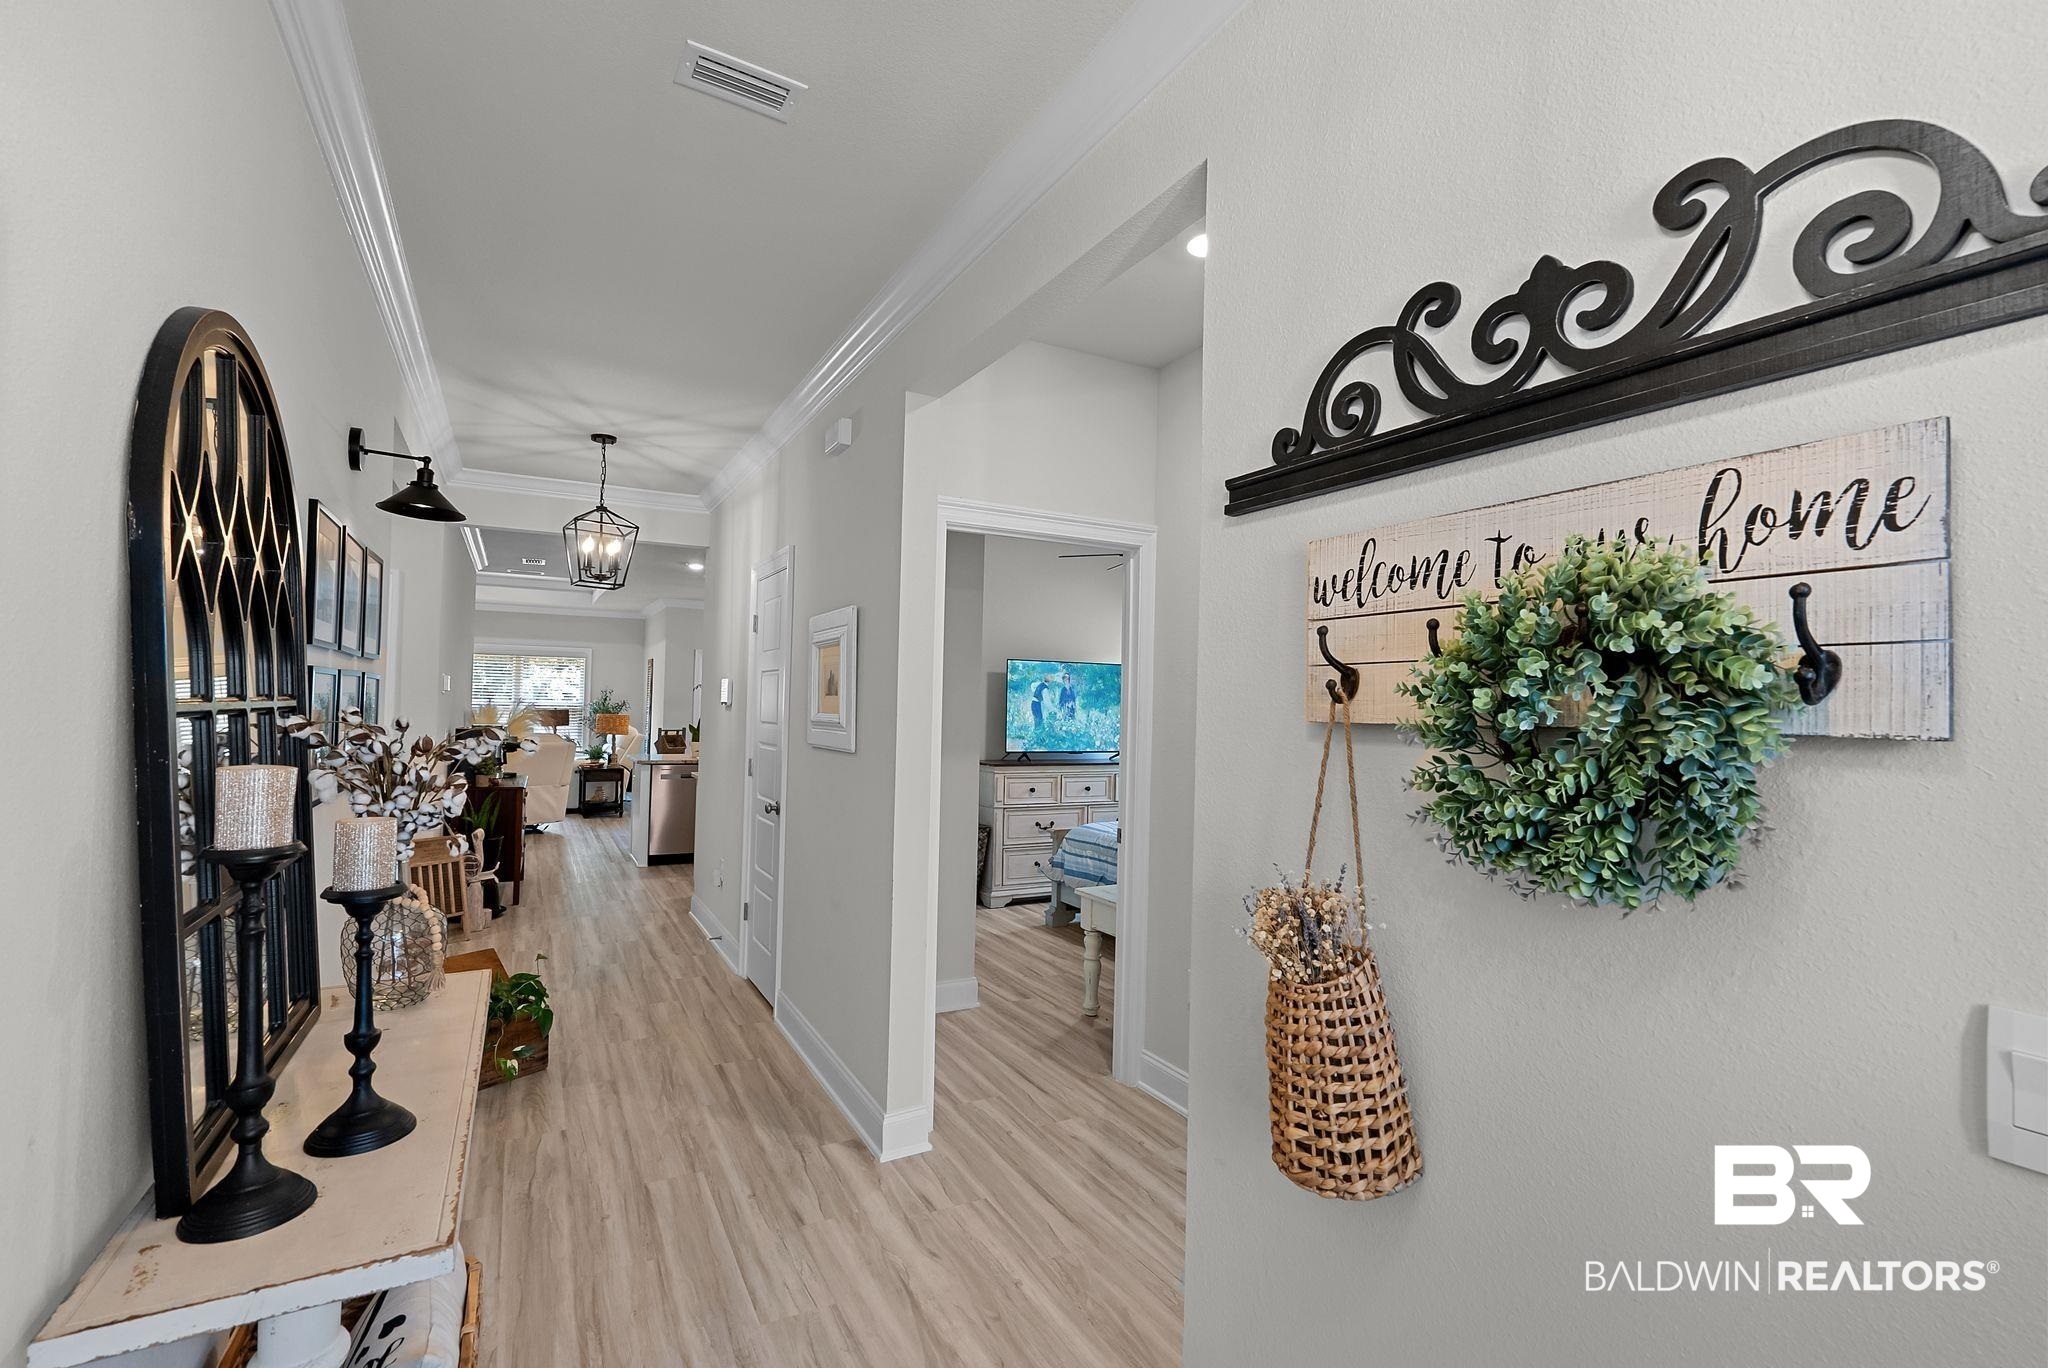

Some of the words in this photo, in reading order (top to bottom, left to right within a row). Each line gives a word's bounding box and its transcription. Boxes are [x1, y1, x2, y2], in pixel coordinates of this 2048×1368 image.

[1313, 537, 1477, 608] welcome
[1484, 529, 1547, 589] to
[1698, 467, 1932, 574] home
